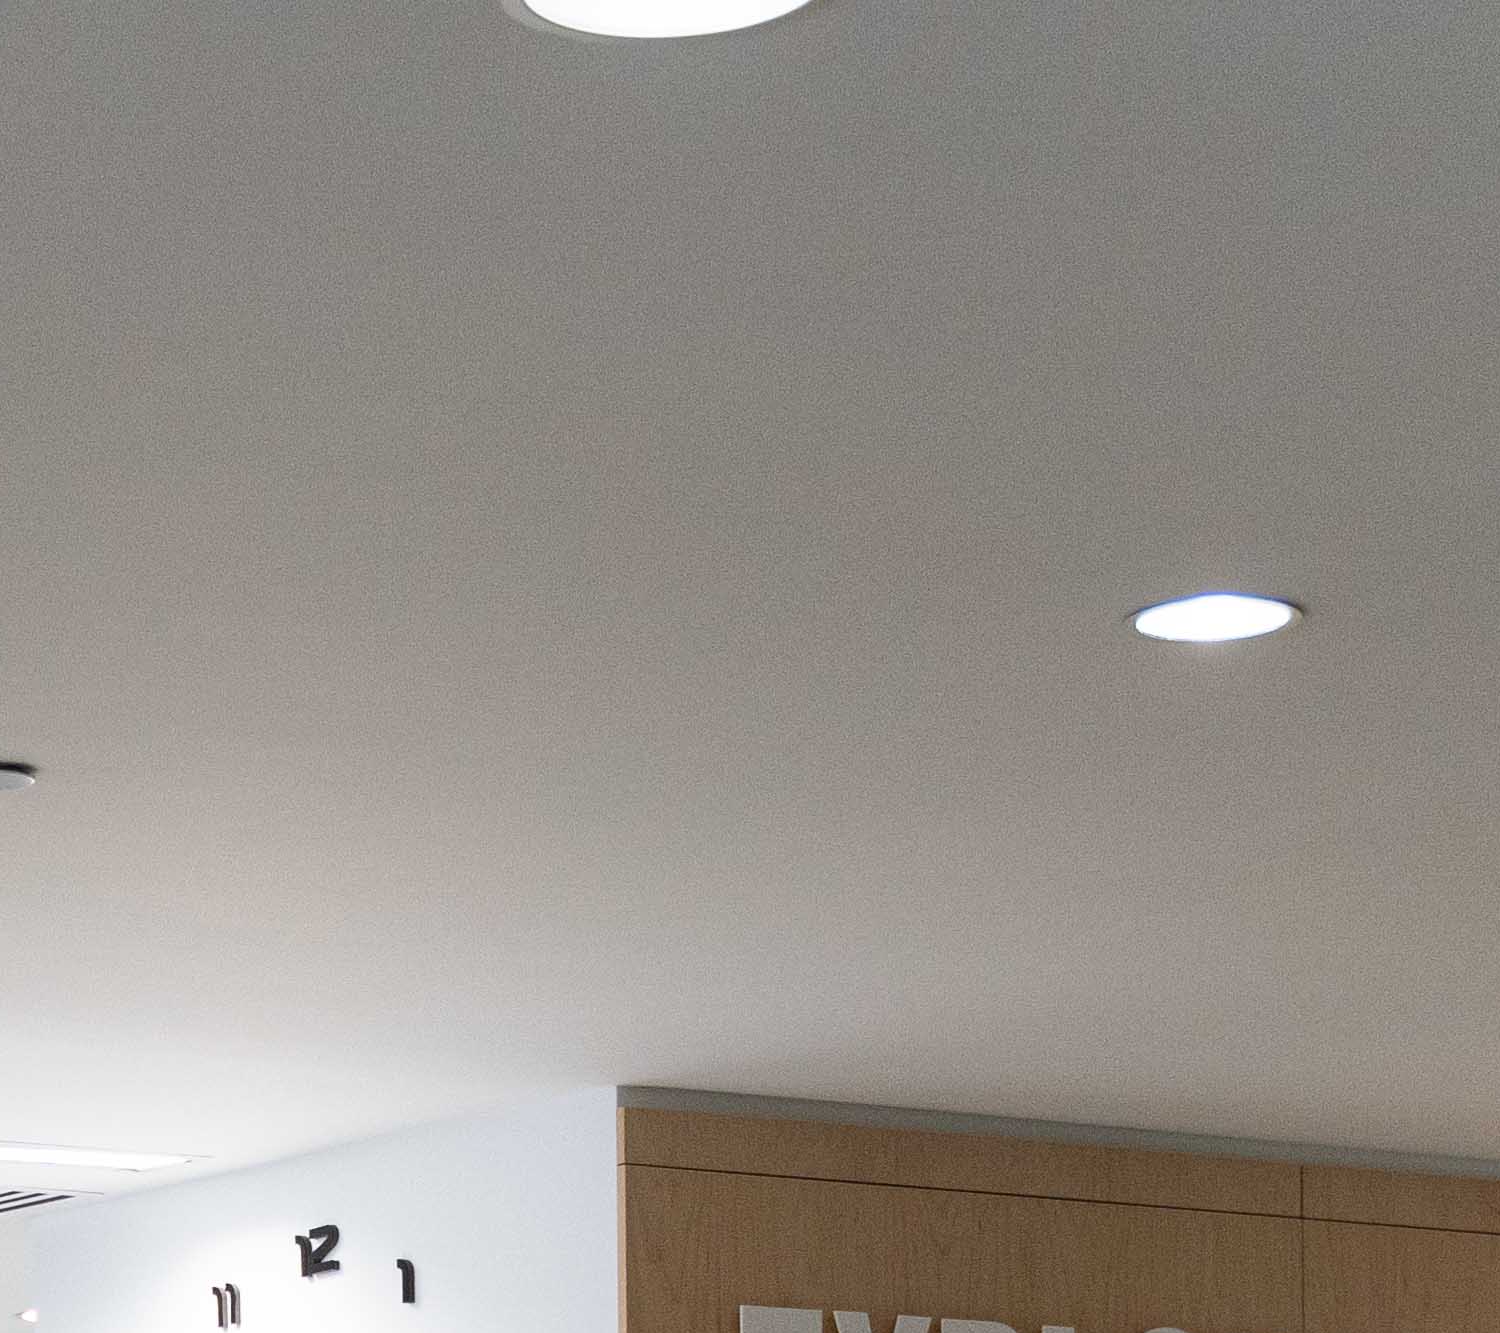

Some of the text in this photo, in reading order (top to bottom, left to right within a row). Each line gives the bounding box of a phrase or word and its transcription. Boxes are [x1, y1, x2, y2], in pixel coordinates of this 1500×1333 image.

[295, 1224, 341, 1278] 12
[396, 1258, 416, 1304] 1
[213, 1284, 241, 1328] 11
